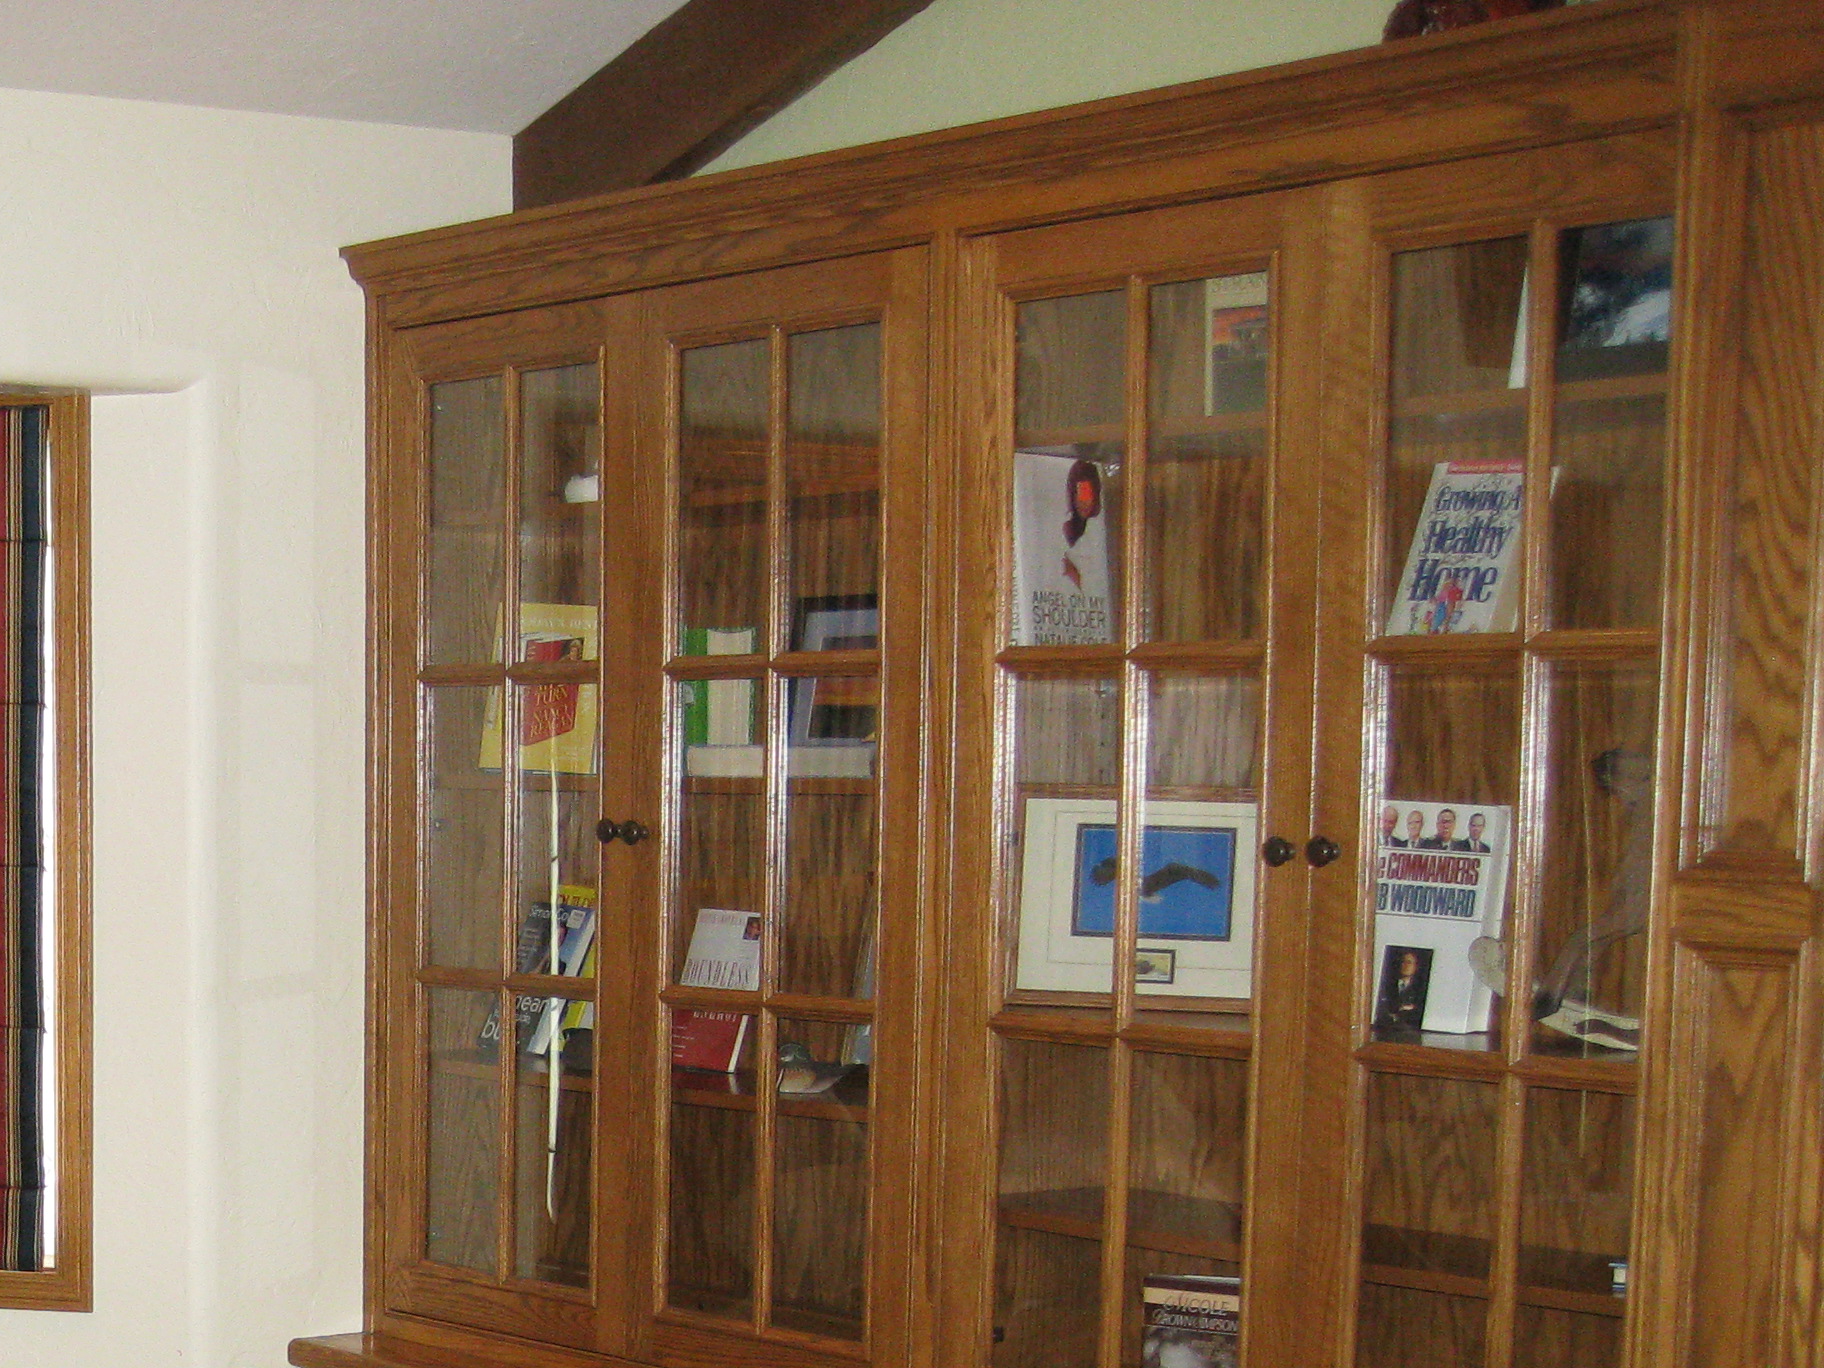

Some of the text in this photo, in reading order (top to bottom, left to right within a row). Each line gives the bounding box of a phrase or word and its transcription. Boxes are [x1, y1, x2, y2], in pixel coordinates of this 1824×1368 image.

[1436, 486, 1506, 514] Growing
[1421, 517, 1514, 559] Healthy
[1408, 557, 1498, 602] Home
[1032, 591, 1106, 610] ANGEL ON MY
[1032, 605, 1107, 629] SHOULDER
[1387, 852, 1481, 886] COMMANDERS
[1389, 883, 1476, 918] WOODWARD
[1163, 1292, 1230, 1316] NICOLE
